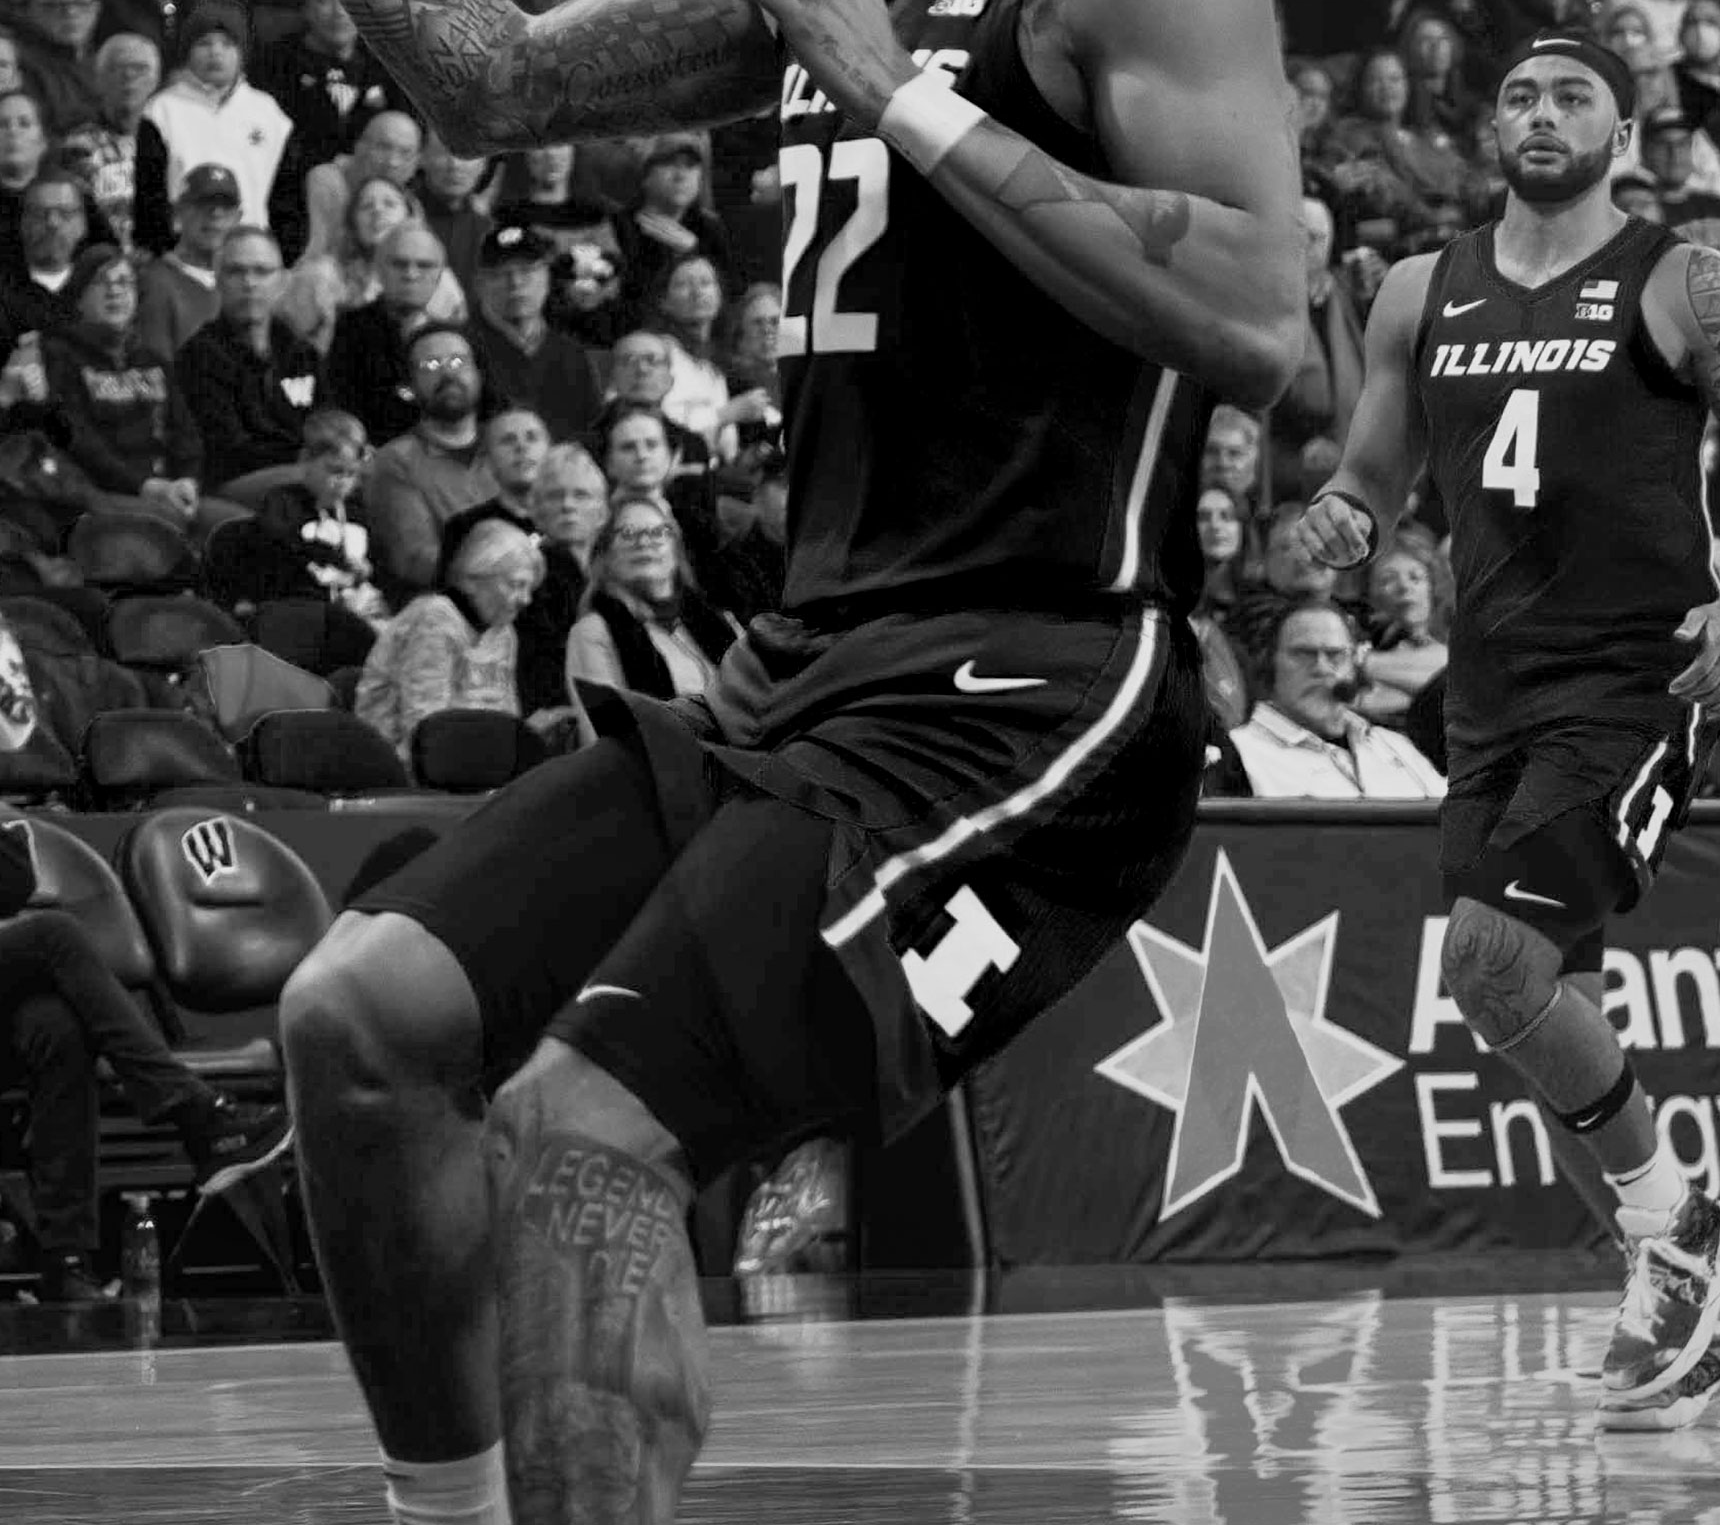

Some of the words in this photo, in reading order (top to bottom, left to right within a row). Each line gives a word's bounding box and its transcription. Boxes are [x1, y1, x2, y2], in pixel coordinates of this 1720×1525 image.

[778, 137, 891, 359] 22
[1430, 339, 1617, 378] ILLINOIS
[1482, 388, 1541, 508] 4
[181, 816, 237, 885] W
